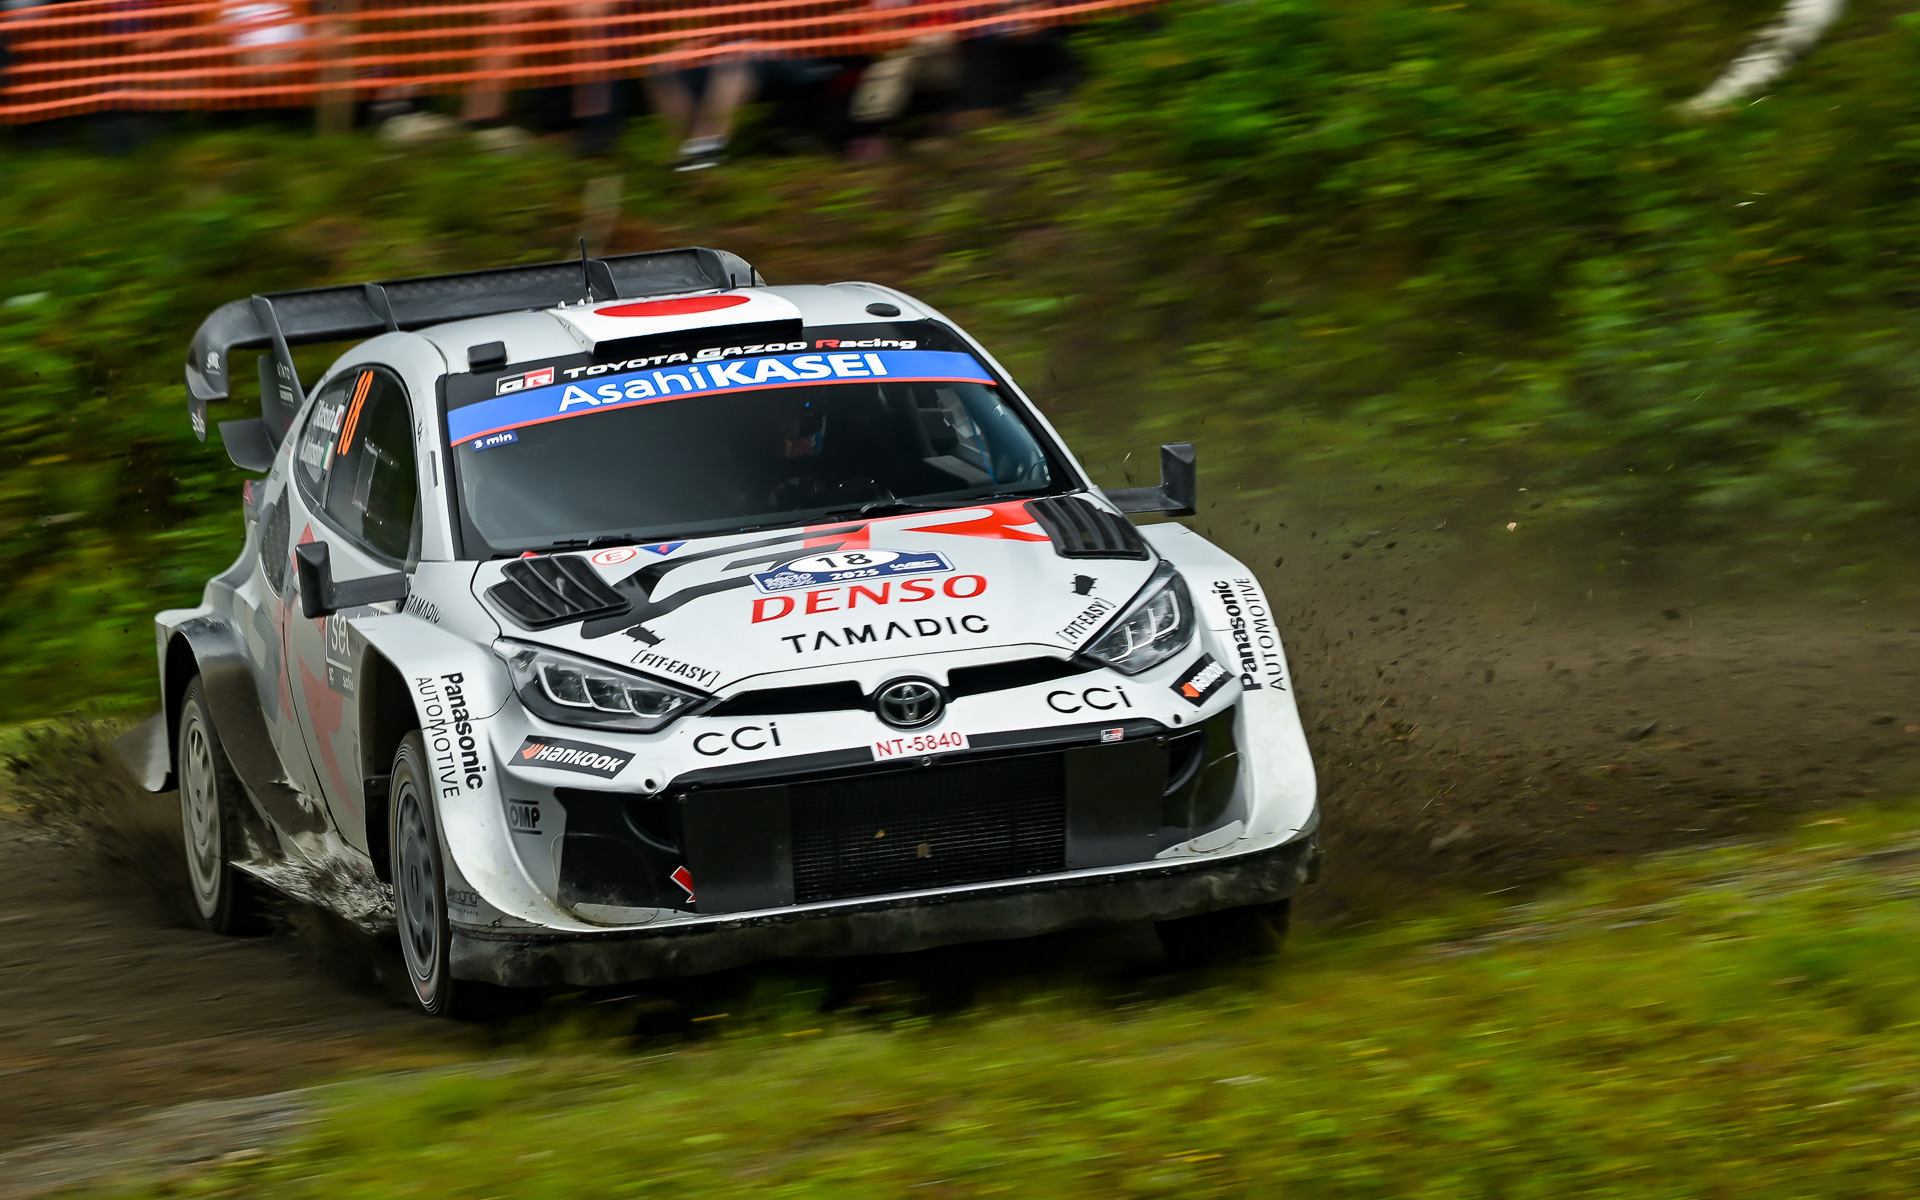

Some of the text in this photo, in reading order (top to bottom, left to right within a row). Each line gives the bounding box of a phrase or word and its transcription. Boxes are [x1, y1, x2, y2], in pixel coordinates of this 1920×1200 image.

[563, 338, 917, 379] TOYOTA GAZOO Racing
[498, 369, 554, 394] GR
[486, 433, 513, 446] min
[816, 553, 872, 569] 18
[829, 568, 880, 581] 2025
[406, 595, 440, 624] TAMADIC
[751, 574, 988, 624] DENSO
[781, 614, 989, 654] TAMADIC
[1211, 580, 1263, 691] Panasonic
[1233, 578, 1286, 692] AUTOMOTIVE
[415, 677, 460, 798] AUTOMOTIVE
[441, 672, 486, 790] Panasonic
[876, 732, 963, 758] NT-5840
[509, 804, 540, 829] OMP
